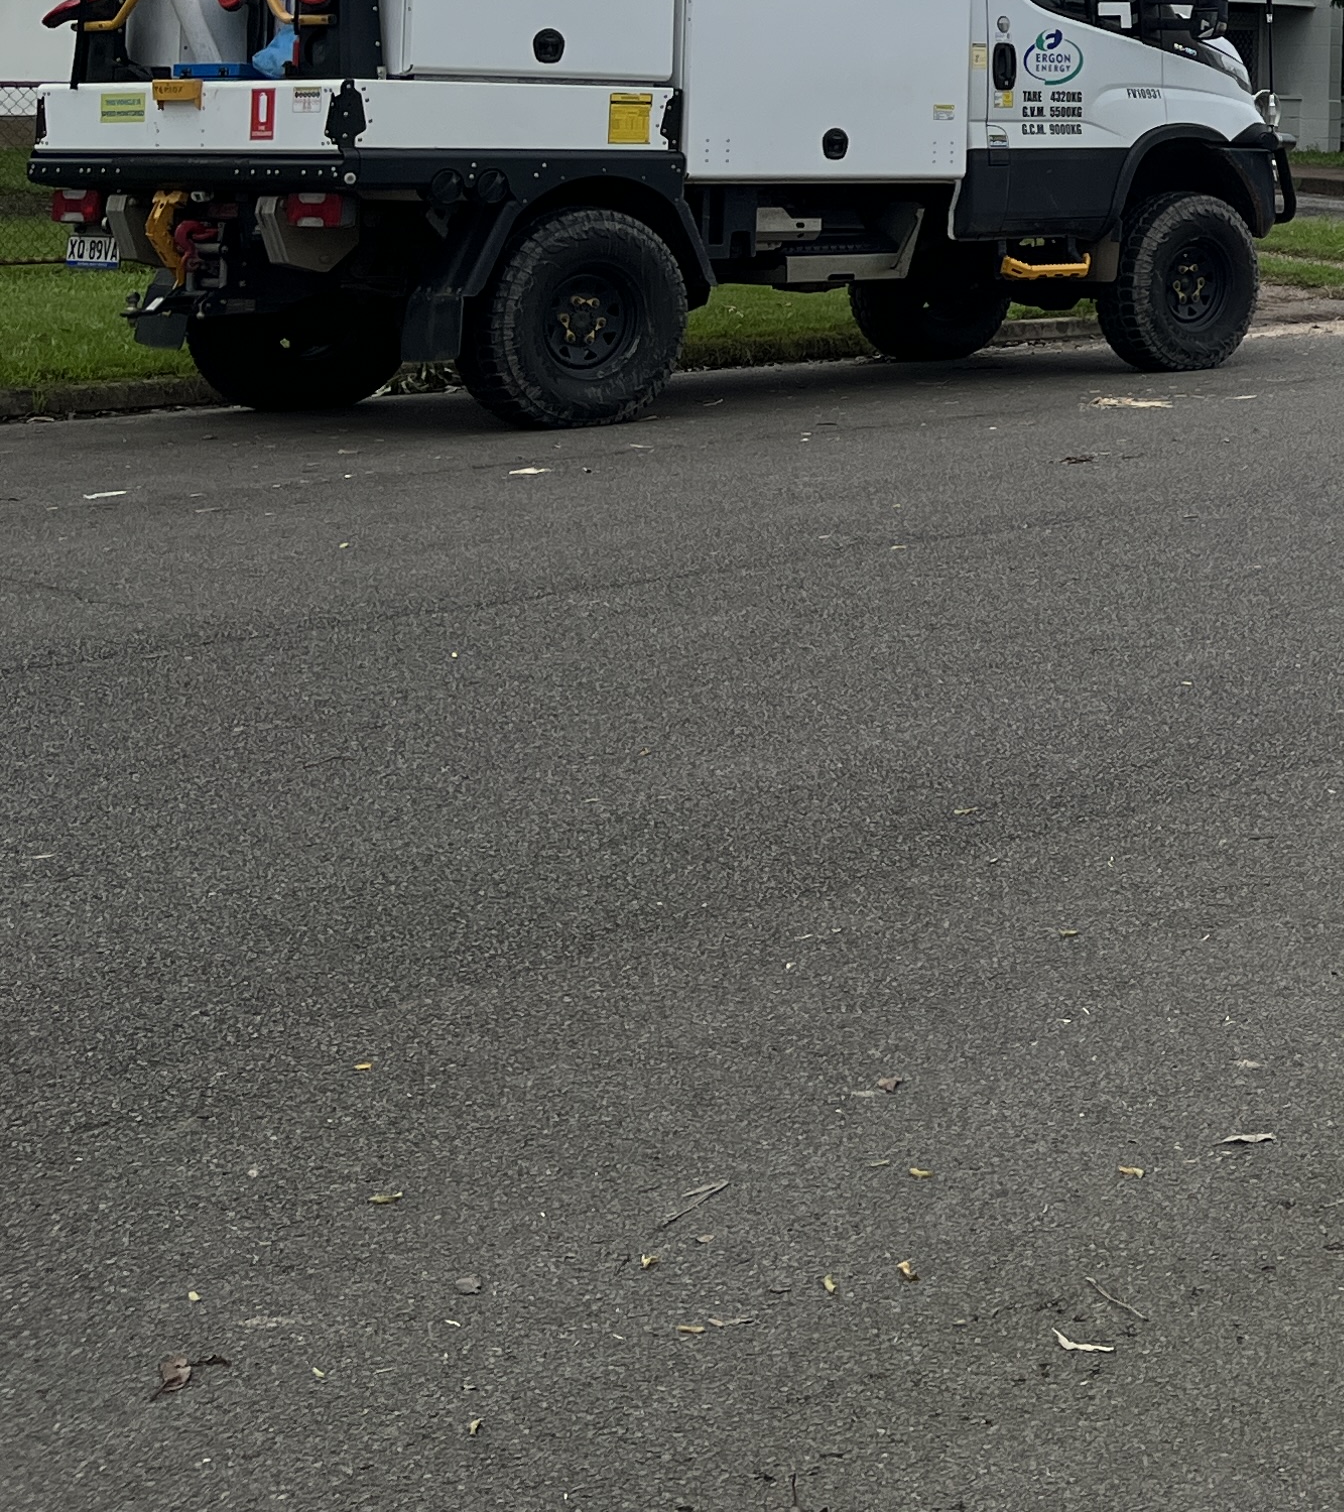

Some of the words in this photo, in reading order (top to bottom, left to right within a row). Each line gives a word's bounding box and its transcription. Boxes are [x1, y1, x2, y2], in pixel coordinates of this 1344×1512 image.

[1036, 53, 1071, 64] ERGON
[1036, 64, 1071, 73] ENERGY
[1022, 91, 1042, 102] TARE
[1050, 91, 1082, 102] 4320KG
[68, 239, 85, 259] XQ
[89, 240, 118, 261] 89VA
